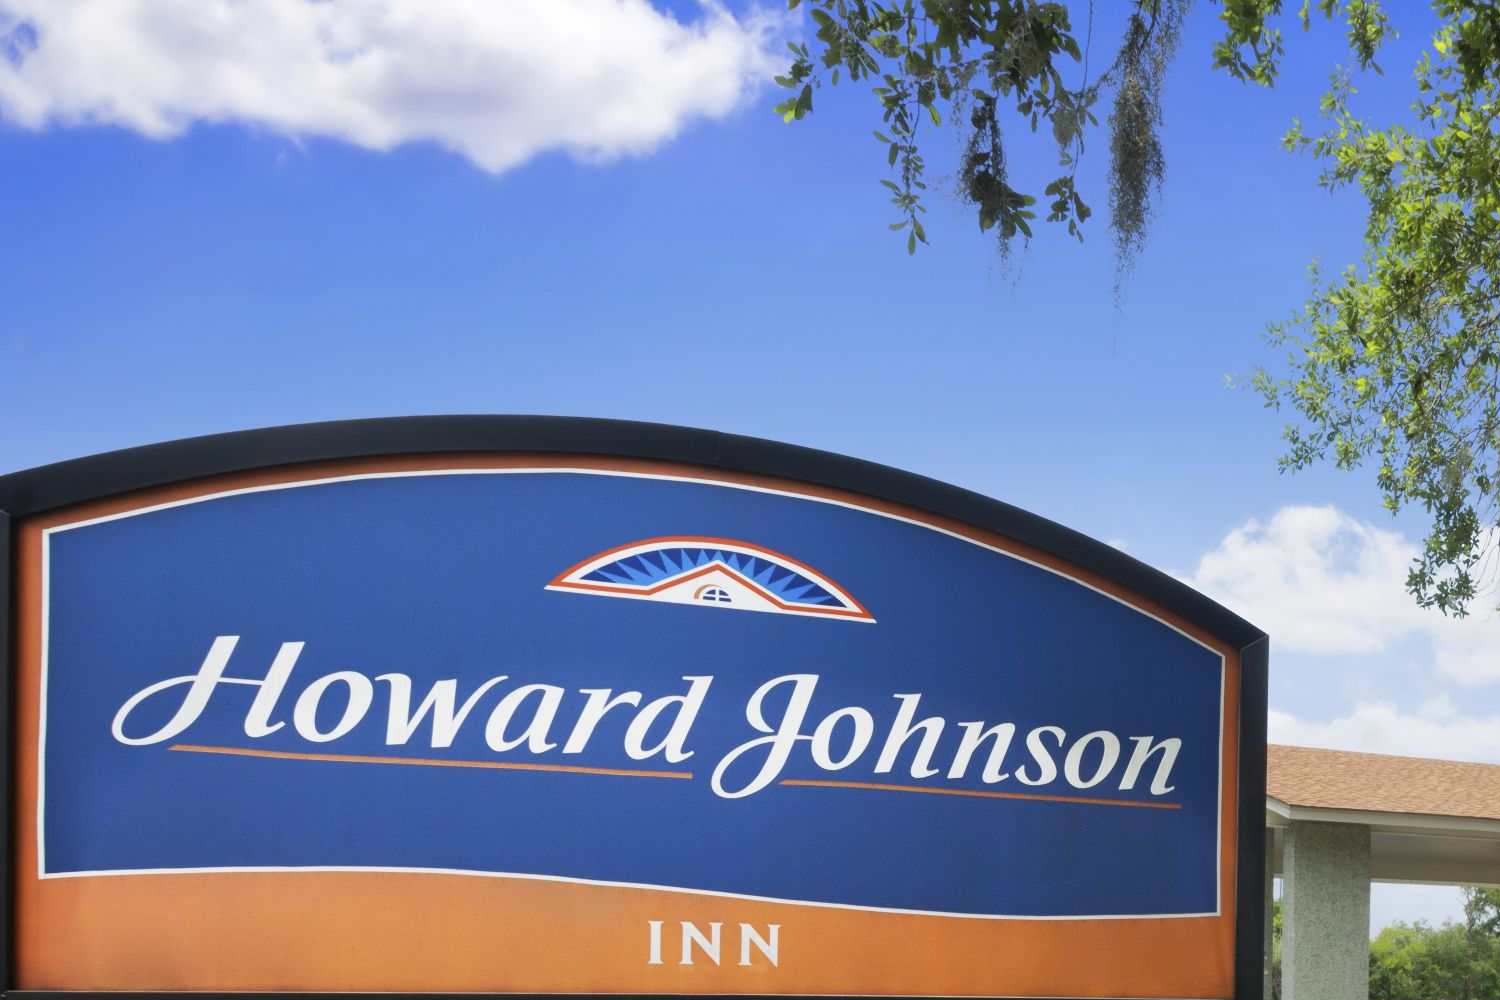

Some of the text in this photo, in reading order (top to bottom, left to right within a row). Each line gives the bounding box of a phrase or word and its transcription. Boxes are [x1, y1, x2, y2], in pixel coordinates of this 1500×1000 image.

[111, 635, 1182, 799] Howard Johnson
[648, 920, 781, 967] INN
